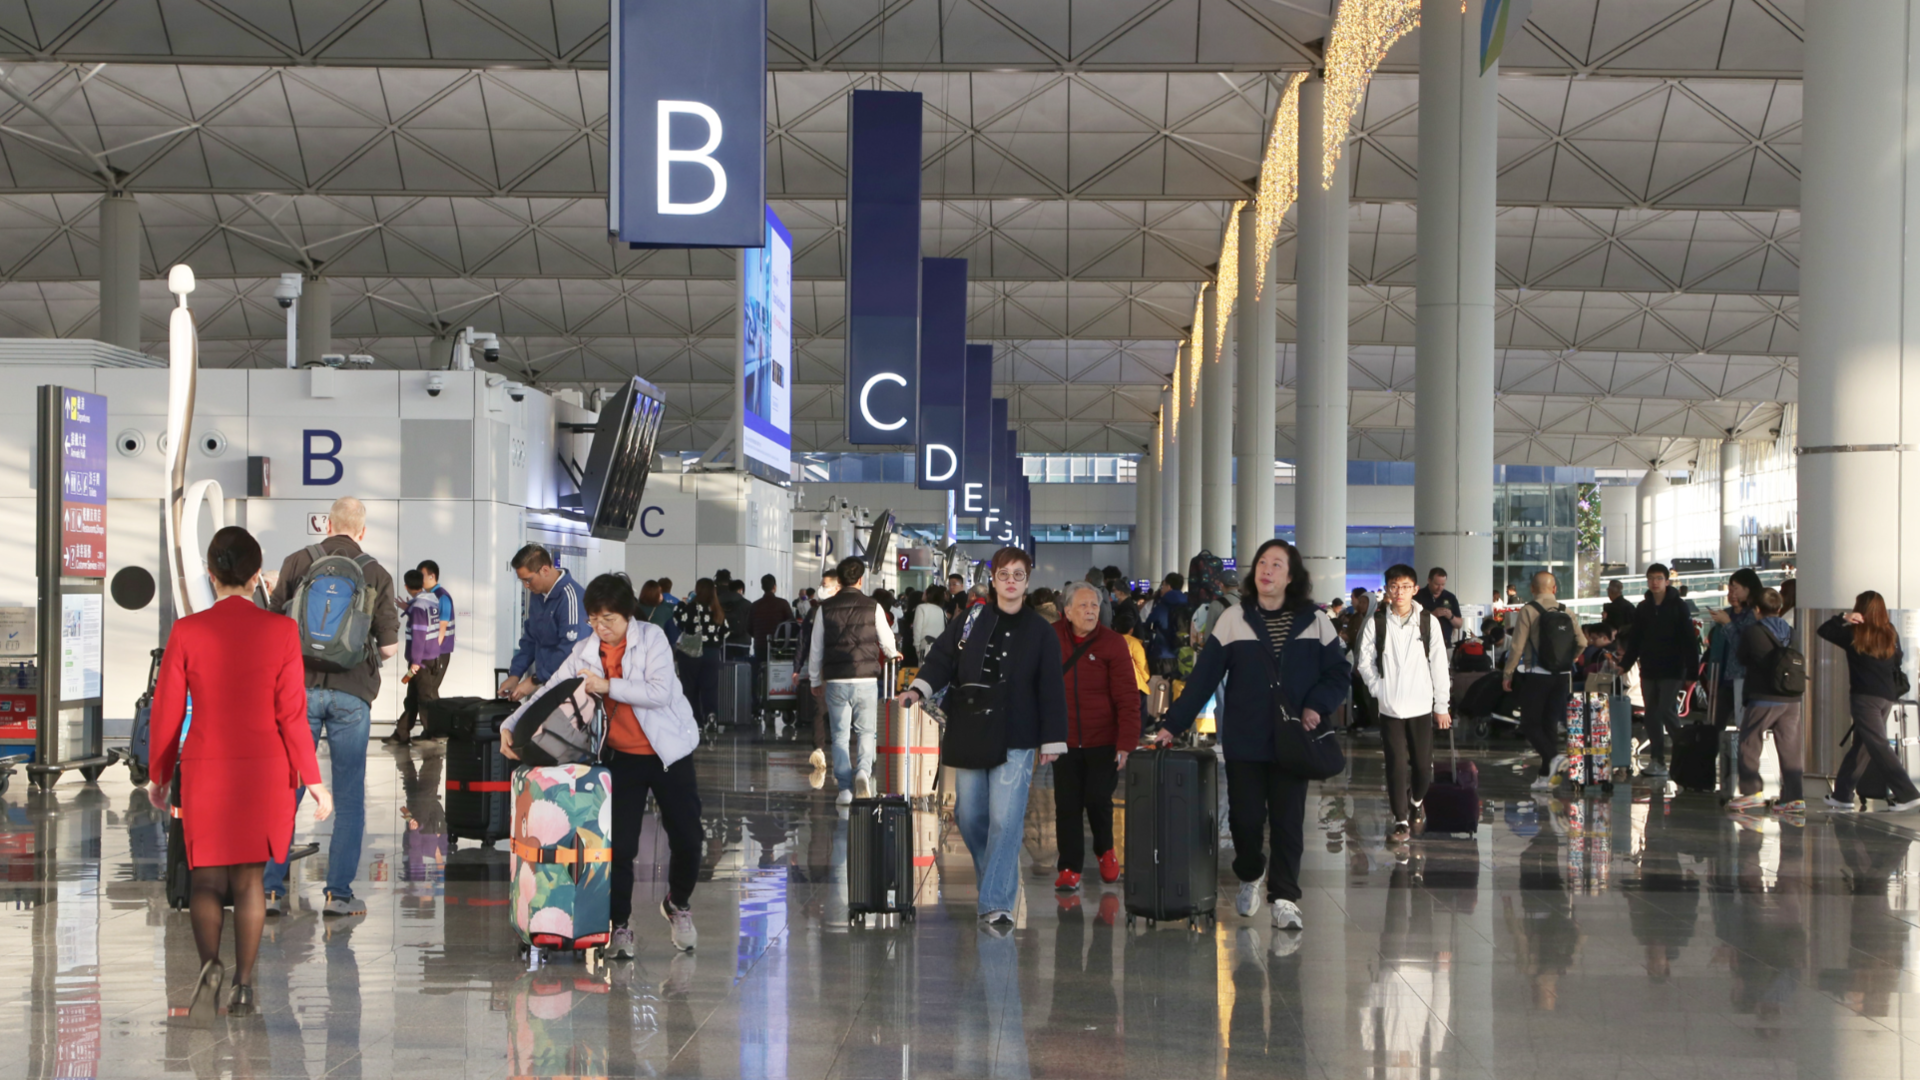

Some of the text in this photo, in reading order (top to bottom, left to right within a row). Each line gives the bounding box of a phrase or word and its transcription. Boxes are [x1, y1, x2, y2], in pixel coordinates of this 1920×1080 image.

[656, 99, 728, 216] B
[859, 372, 908, 431] C
[302, 429, 344, 486] B
[925, 443, 957, 482] D
[964, 482, 983, 512] E
[640, 505, 664, 538] C
[985, 508, 1000, 532] F
[815, 534, 834, 557] D
